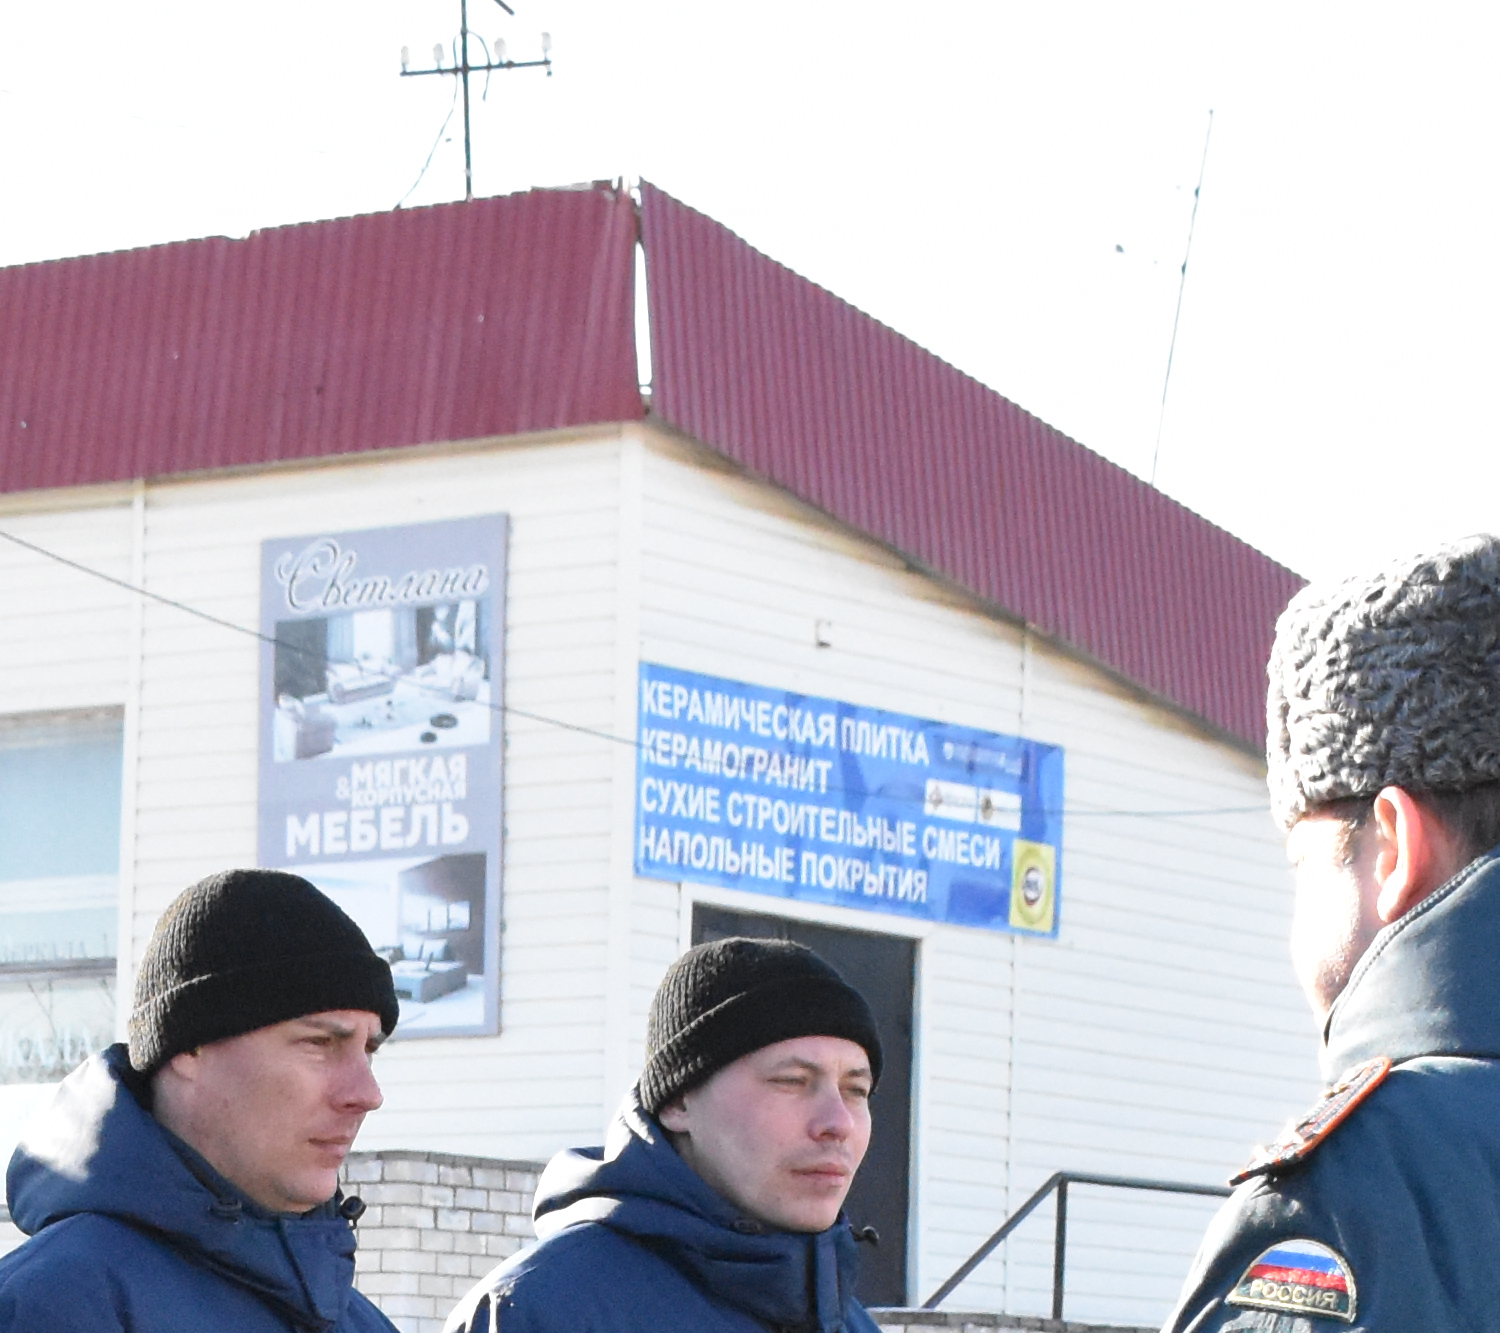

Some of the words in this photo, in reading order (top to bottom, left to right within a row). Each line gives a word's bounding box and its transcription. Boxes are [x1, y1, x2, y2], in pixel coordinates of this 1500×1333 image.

[275, 538, 488, 613] Светлана
[643, 680, 836, 747] КЕРАМИЧЕСКАЯ
[841, 717, 930, 766] ПЛИТКА
[351, 754, 467, 789] МЯГКАЯ
[352, 780, 467, 808] КОРПУСНАЯ
[642, 728, 833, 794] КЕРАМОГРАНИТ
[286, 803, 470, 858] МЕБЕЛЬ
[641, 777, 721, 823] СУХИЕ
[727, 791, 916, 855] СТРОИТЕЛЬНЫЕ
[923, 826, 1000, 870] СМЕСИ
[640, 825, 795, 882] НАПОЛЬНЫЕ
[801, 851, 928, 903] ПОКРЫТИЯ
[1250, 1279, 1337, 1310] РОССИЯ
